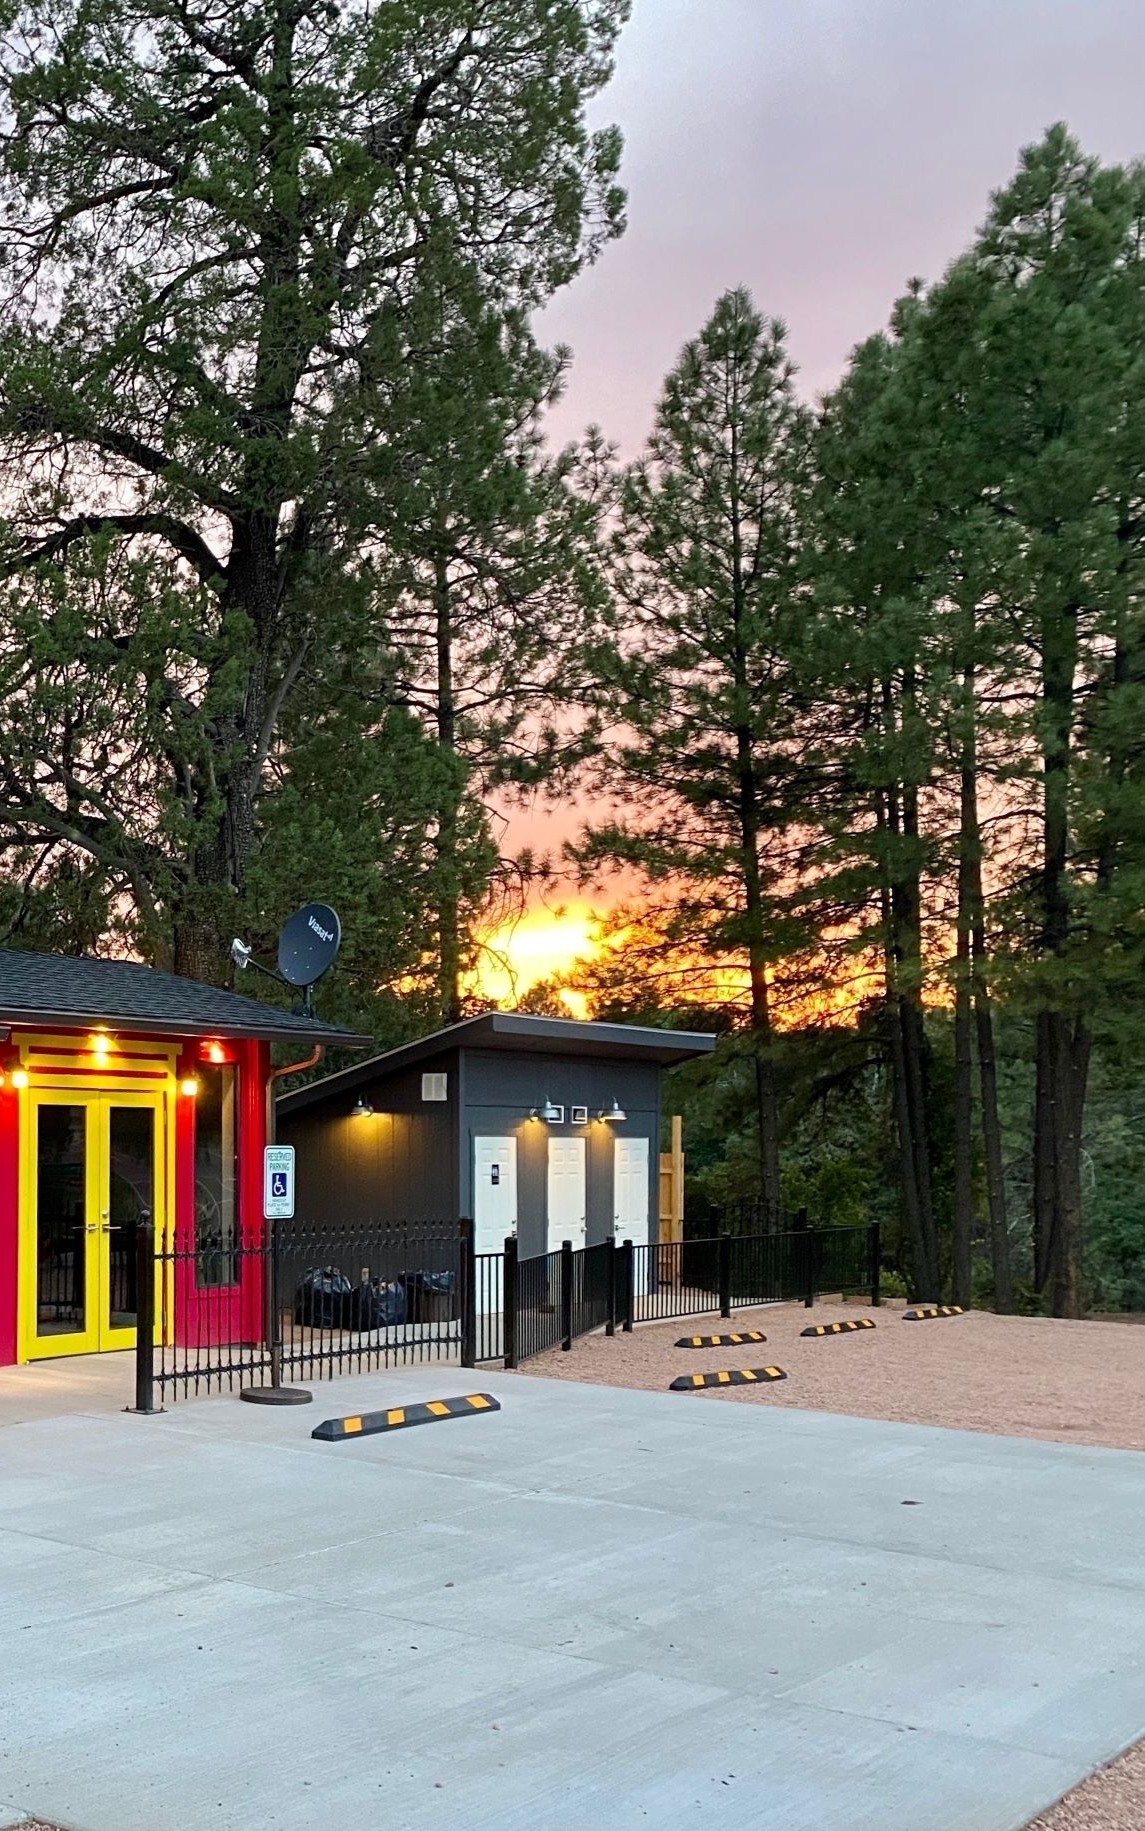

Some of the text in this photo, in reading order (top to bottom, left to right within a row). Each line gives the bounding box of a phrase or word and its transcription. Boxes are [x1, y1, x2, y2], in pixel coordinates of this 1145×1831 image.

[308, 915, 329, 942] Viasat
[267, 1153, 292, 1161] RESERVED
[269, 1162, 290, 1171] PARKING
